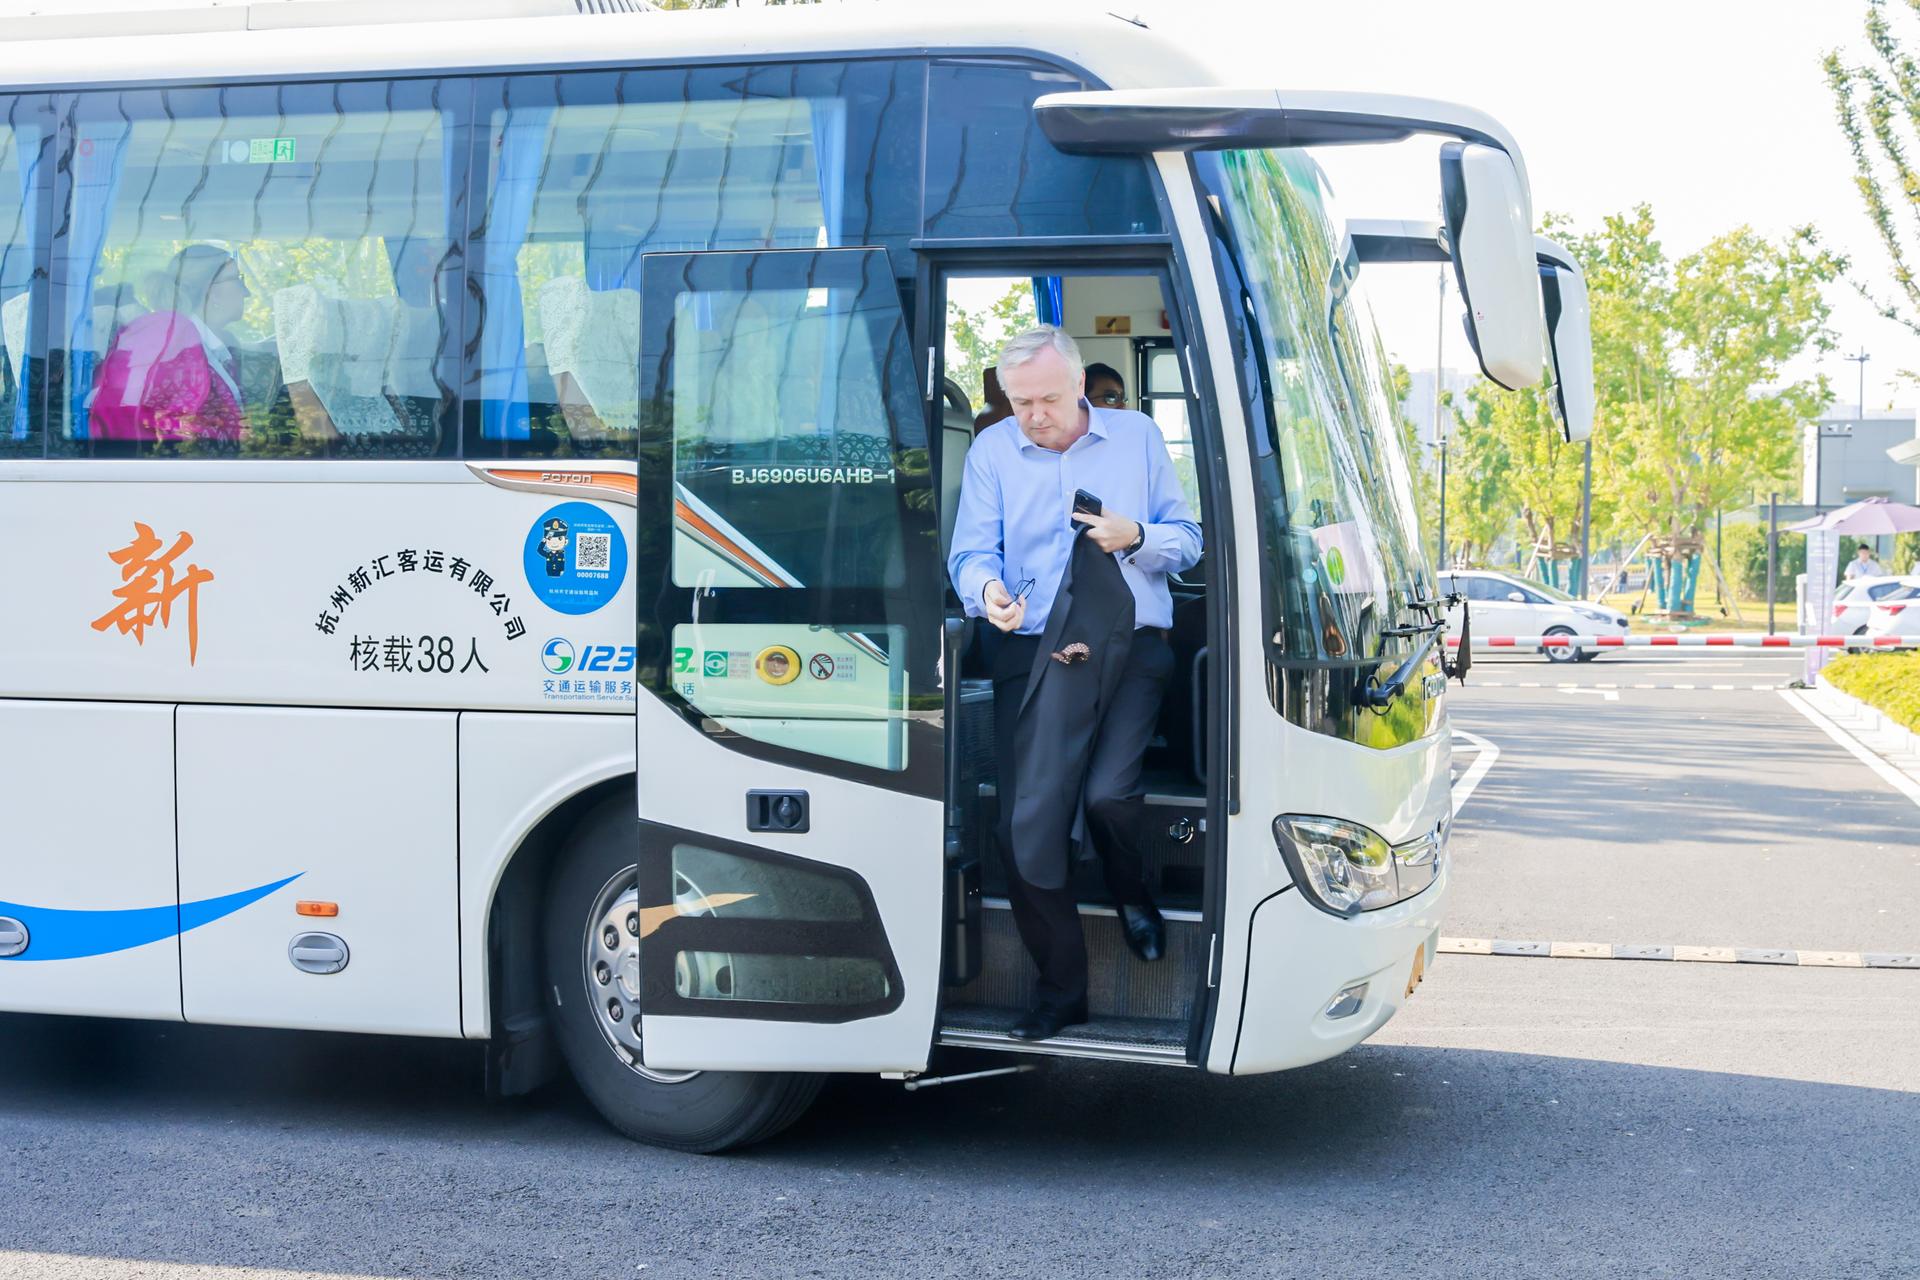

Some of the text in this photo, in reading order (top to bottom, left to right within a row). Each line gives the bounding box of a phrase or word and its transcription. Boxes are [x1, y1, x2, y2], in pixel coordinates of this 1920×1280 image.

[541, 472, 592, 483] FOTON
[731, 467, 896, 485] BJ6906U6AHB-1
[91, 522, 214, 667] 新
[315, 548, 527, 642] 杭州新汇客运有限公司
[349, 634, 490, 674] 核载38人
[544, 692, 595, 701] Transportation
[596, 694, 624, 702] Service
